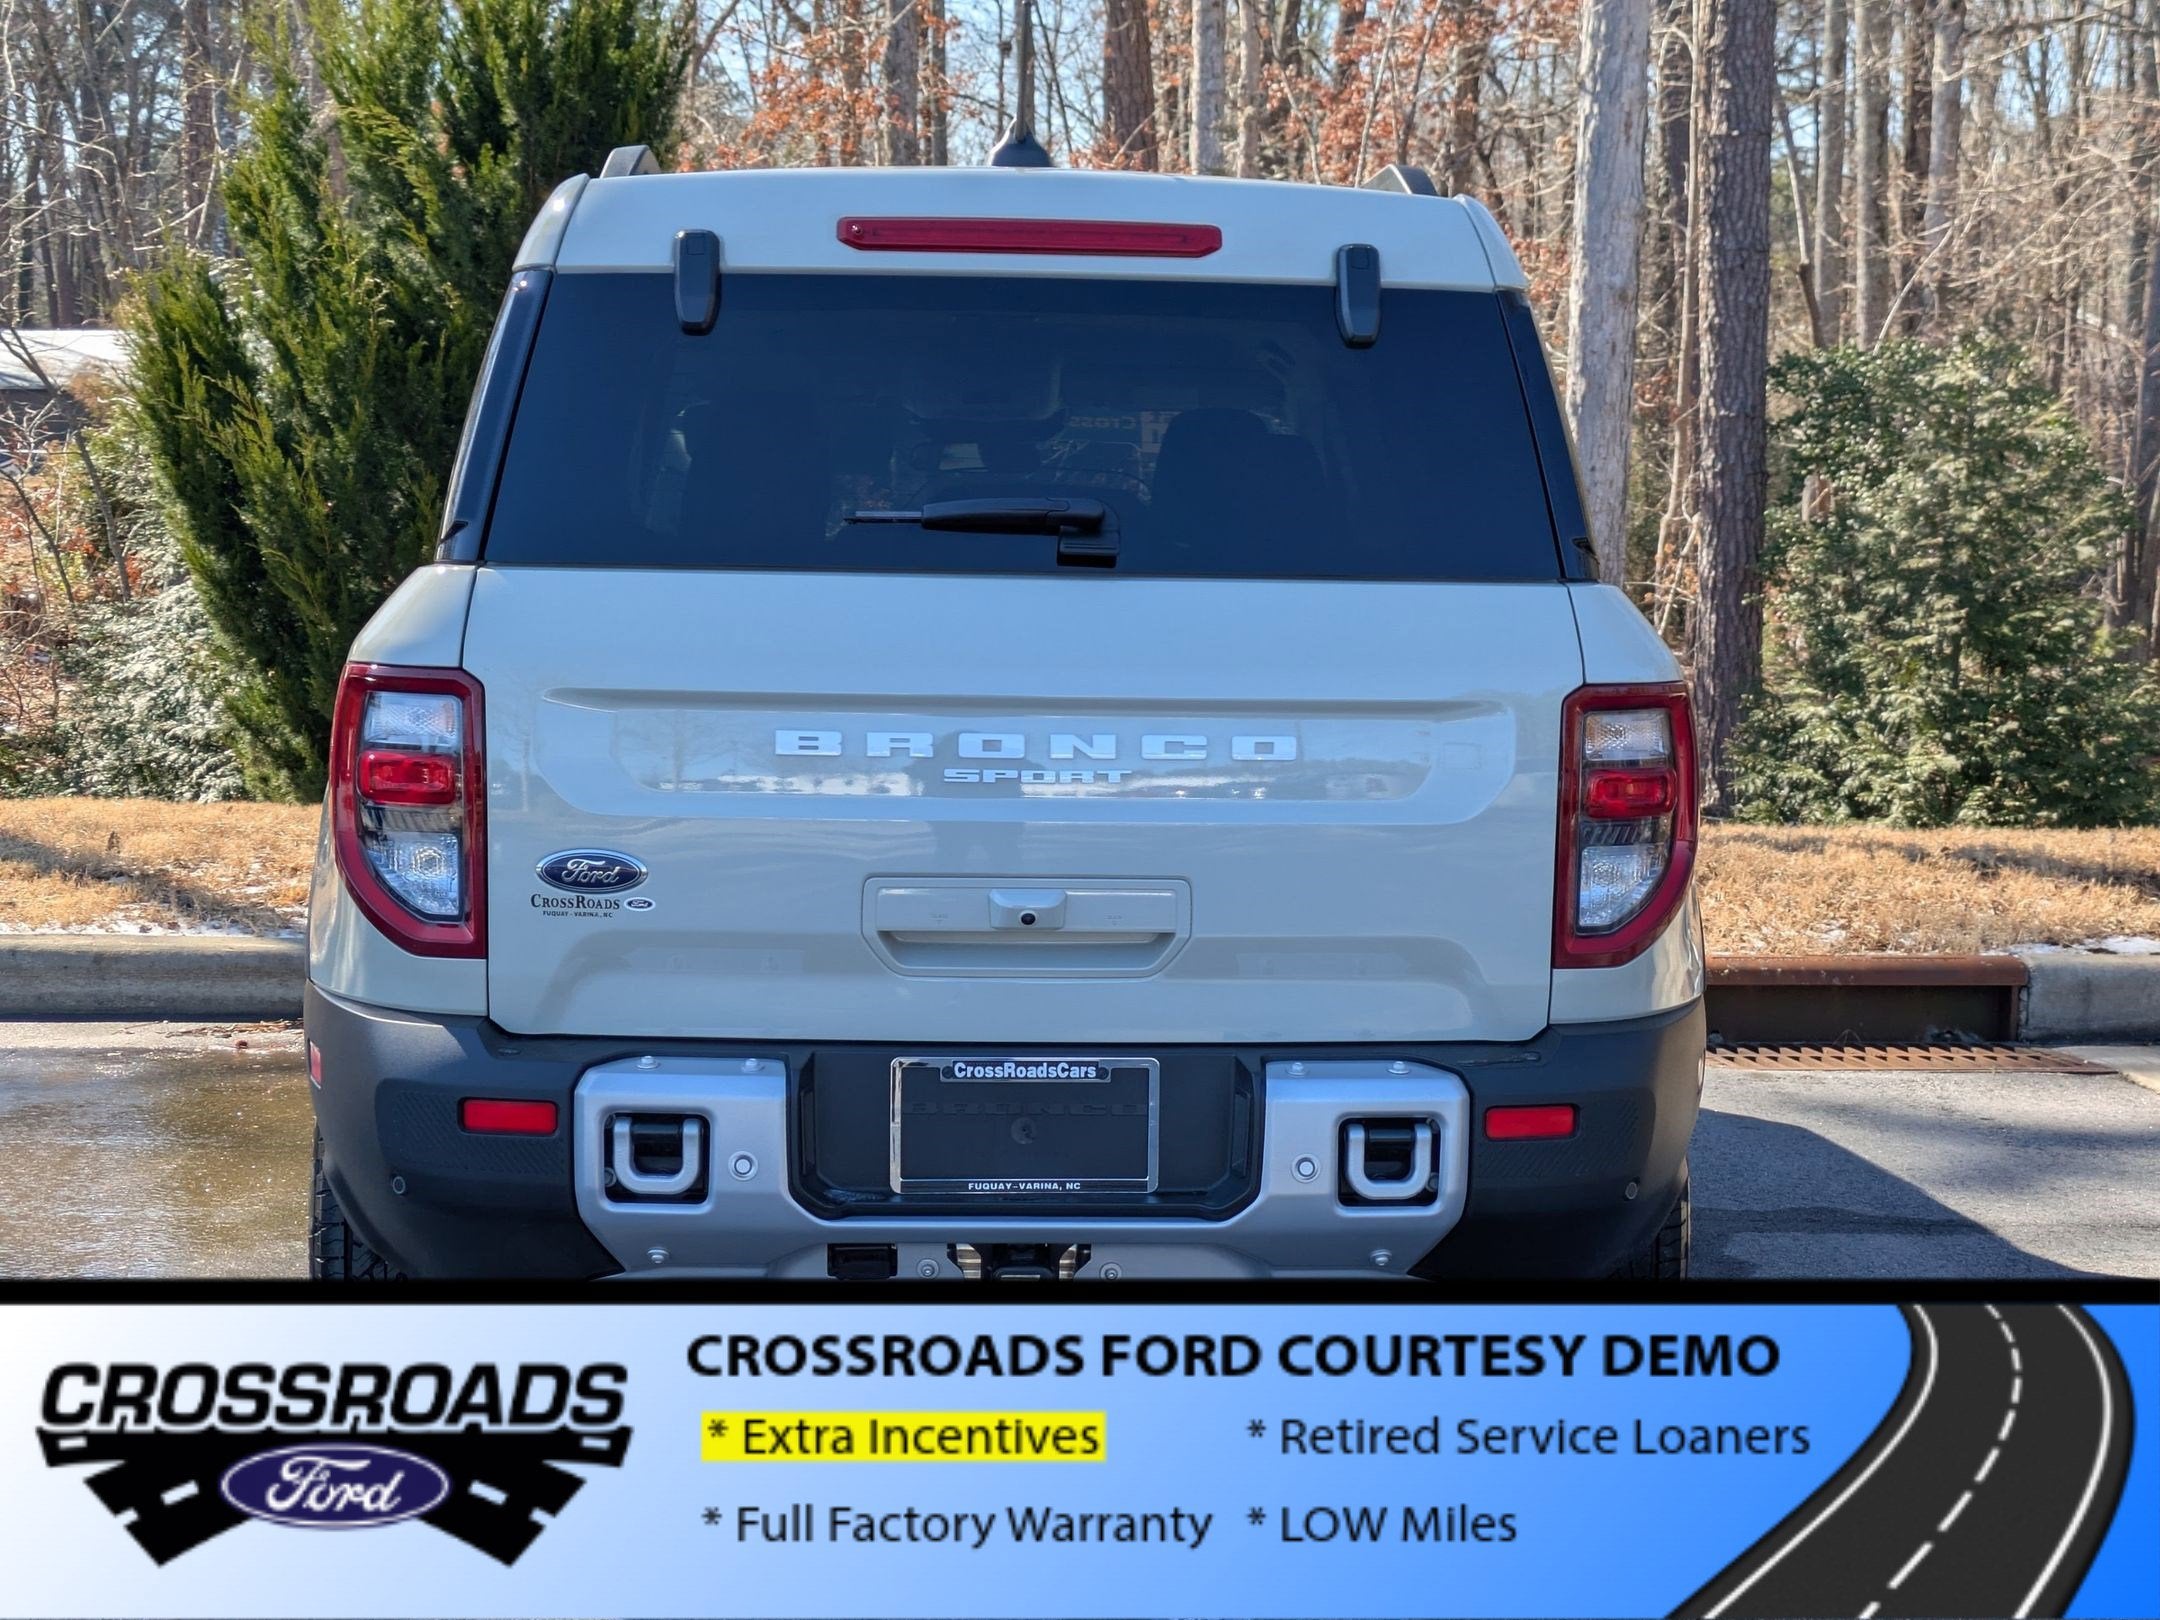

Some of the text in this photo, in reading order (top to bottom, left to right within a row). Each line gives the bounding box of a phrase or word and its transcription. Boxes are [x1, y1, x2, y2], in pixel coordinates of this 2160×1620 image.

[775, 729, 1298, 761] BRONCO
[943, 768, 1132, 785] SPORT
[561, 857, 621, 883] Ford
[953, 1061, 1098, 1080] CrossRoadsCars
[902, 1102, 1148, 1117] BRONCO
[967, 1182, 1082, 1191] FUQUAY-VARINA, NC
